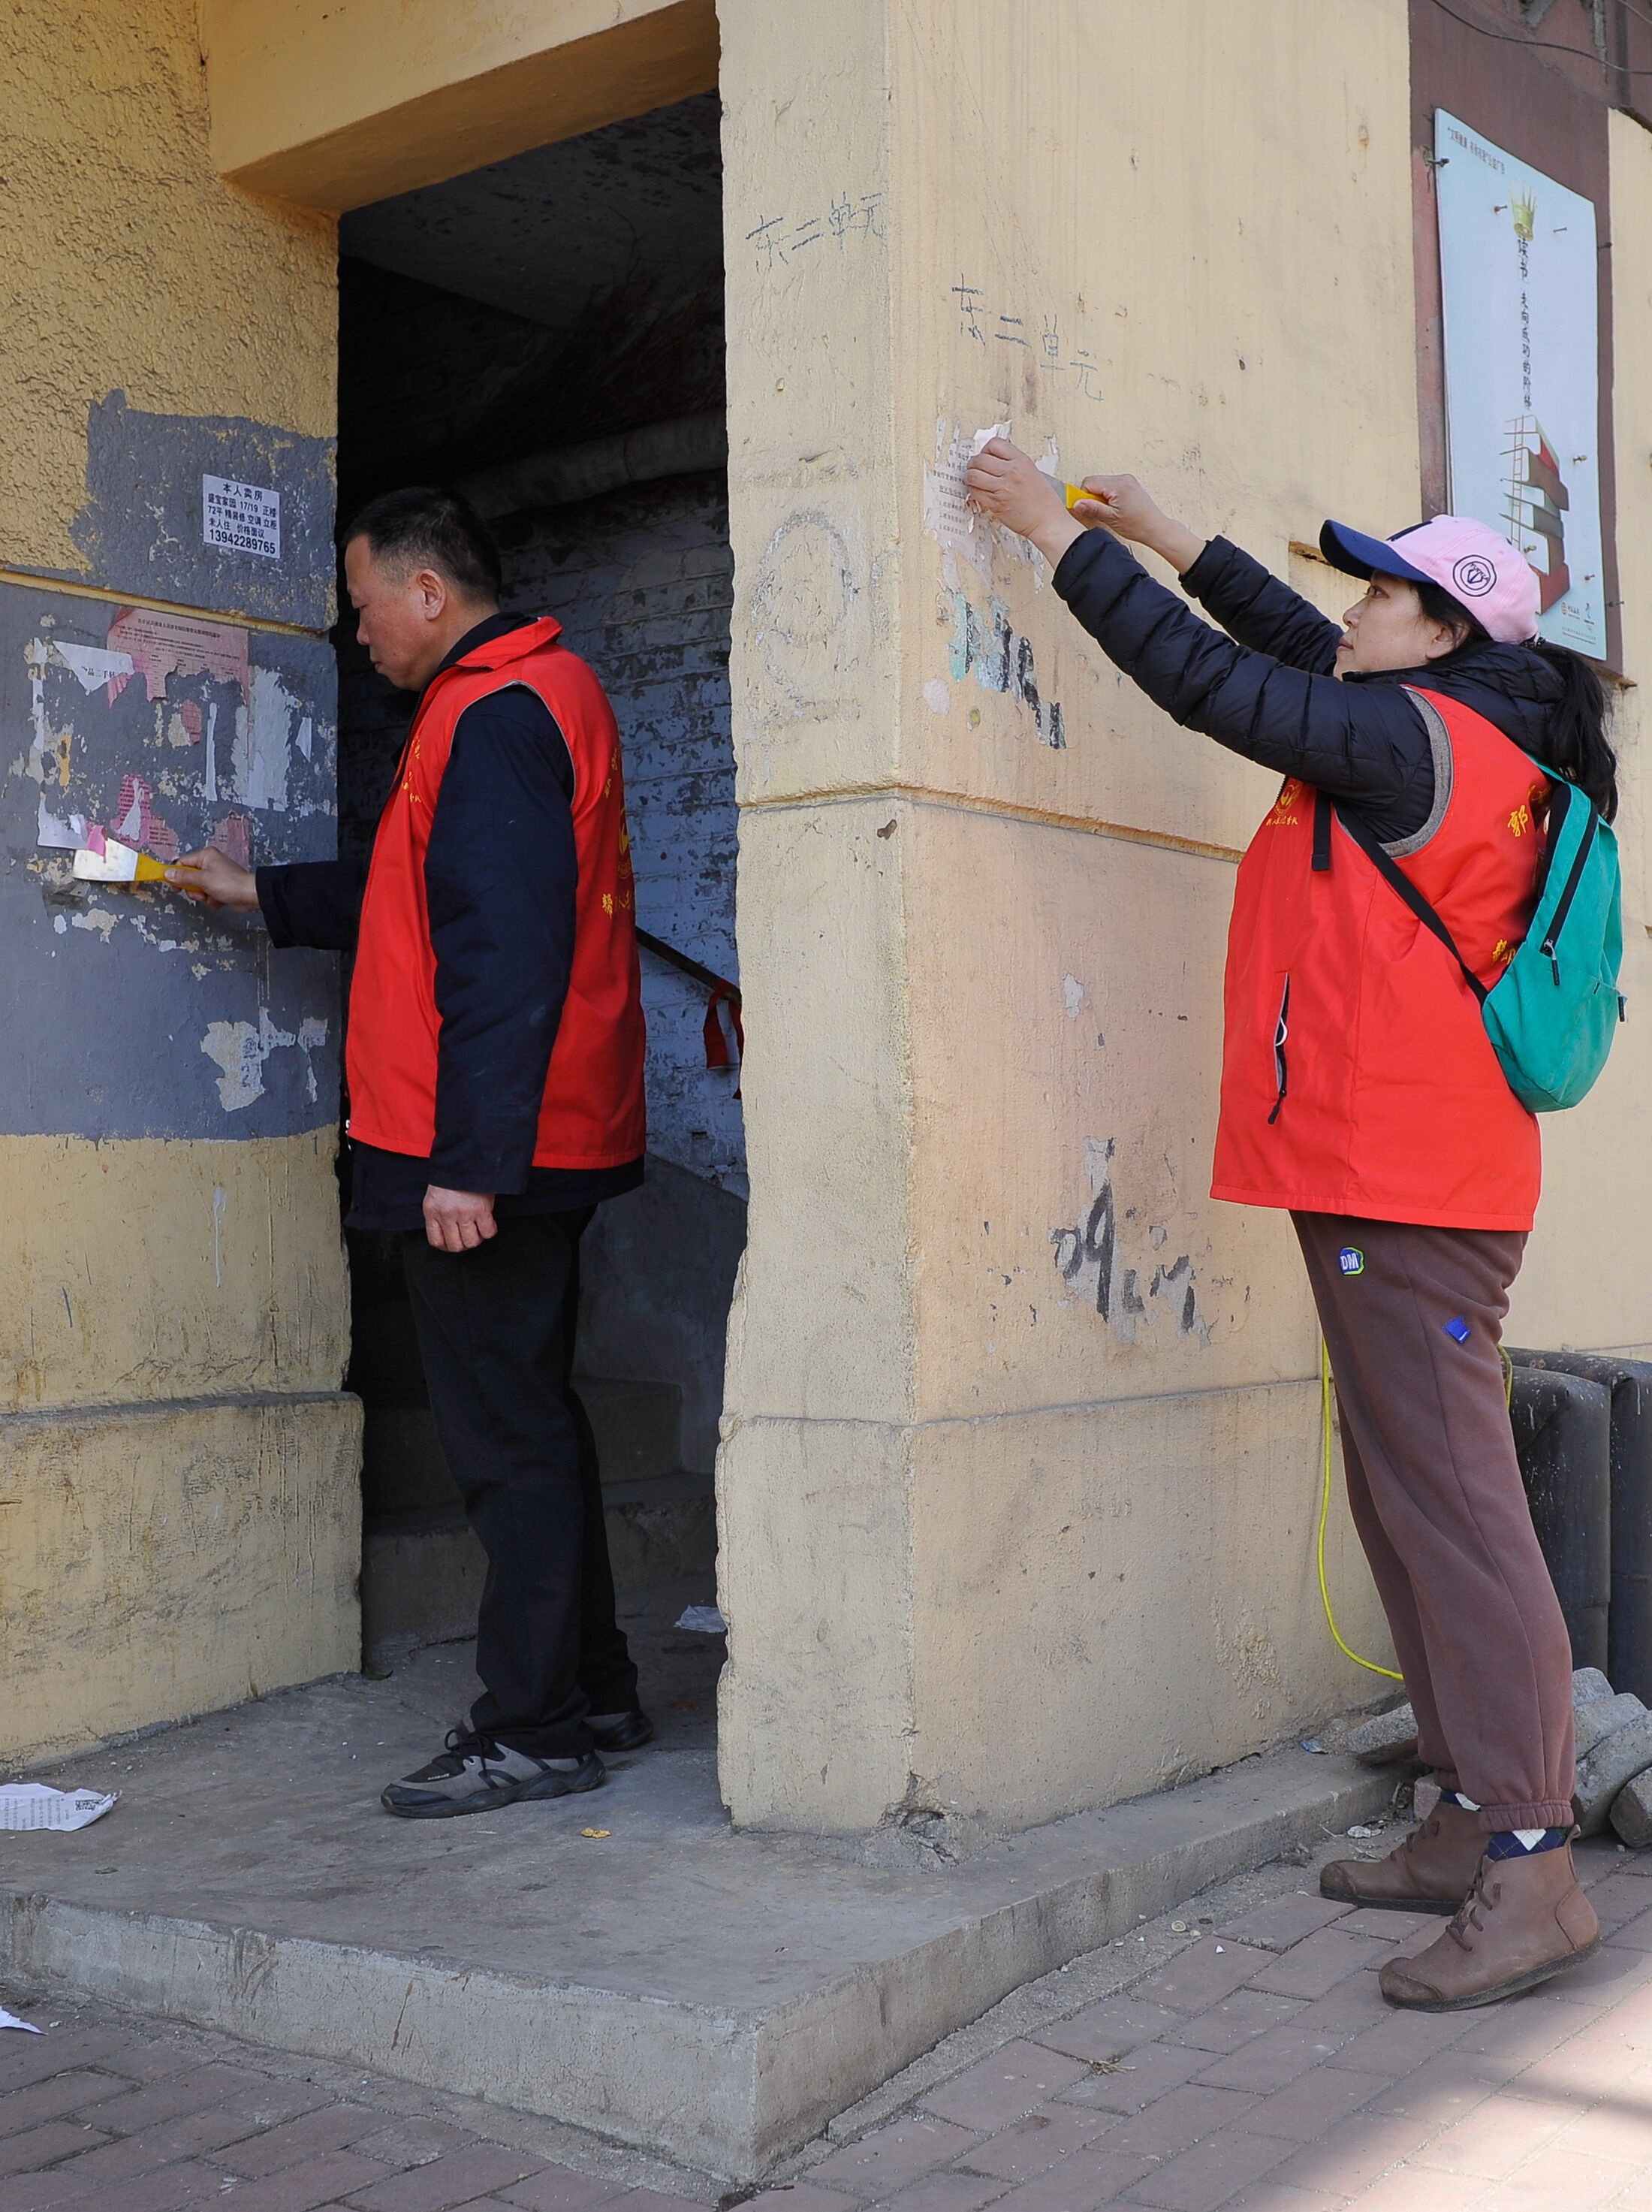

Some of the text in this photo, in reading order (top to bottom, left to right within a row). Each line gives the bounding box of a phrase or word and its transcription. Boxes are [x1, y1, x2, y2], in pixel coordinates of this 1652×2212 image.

[952, 273, 1104, 401] 东二单元
[223, 483, 263, 502] 本人卖房
[240, 501, 258, 513] 17/19
[237, 524, 265, 539] 价格面议
[210, 529, 276, 554] 13942289765
